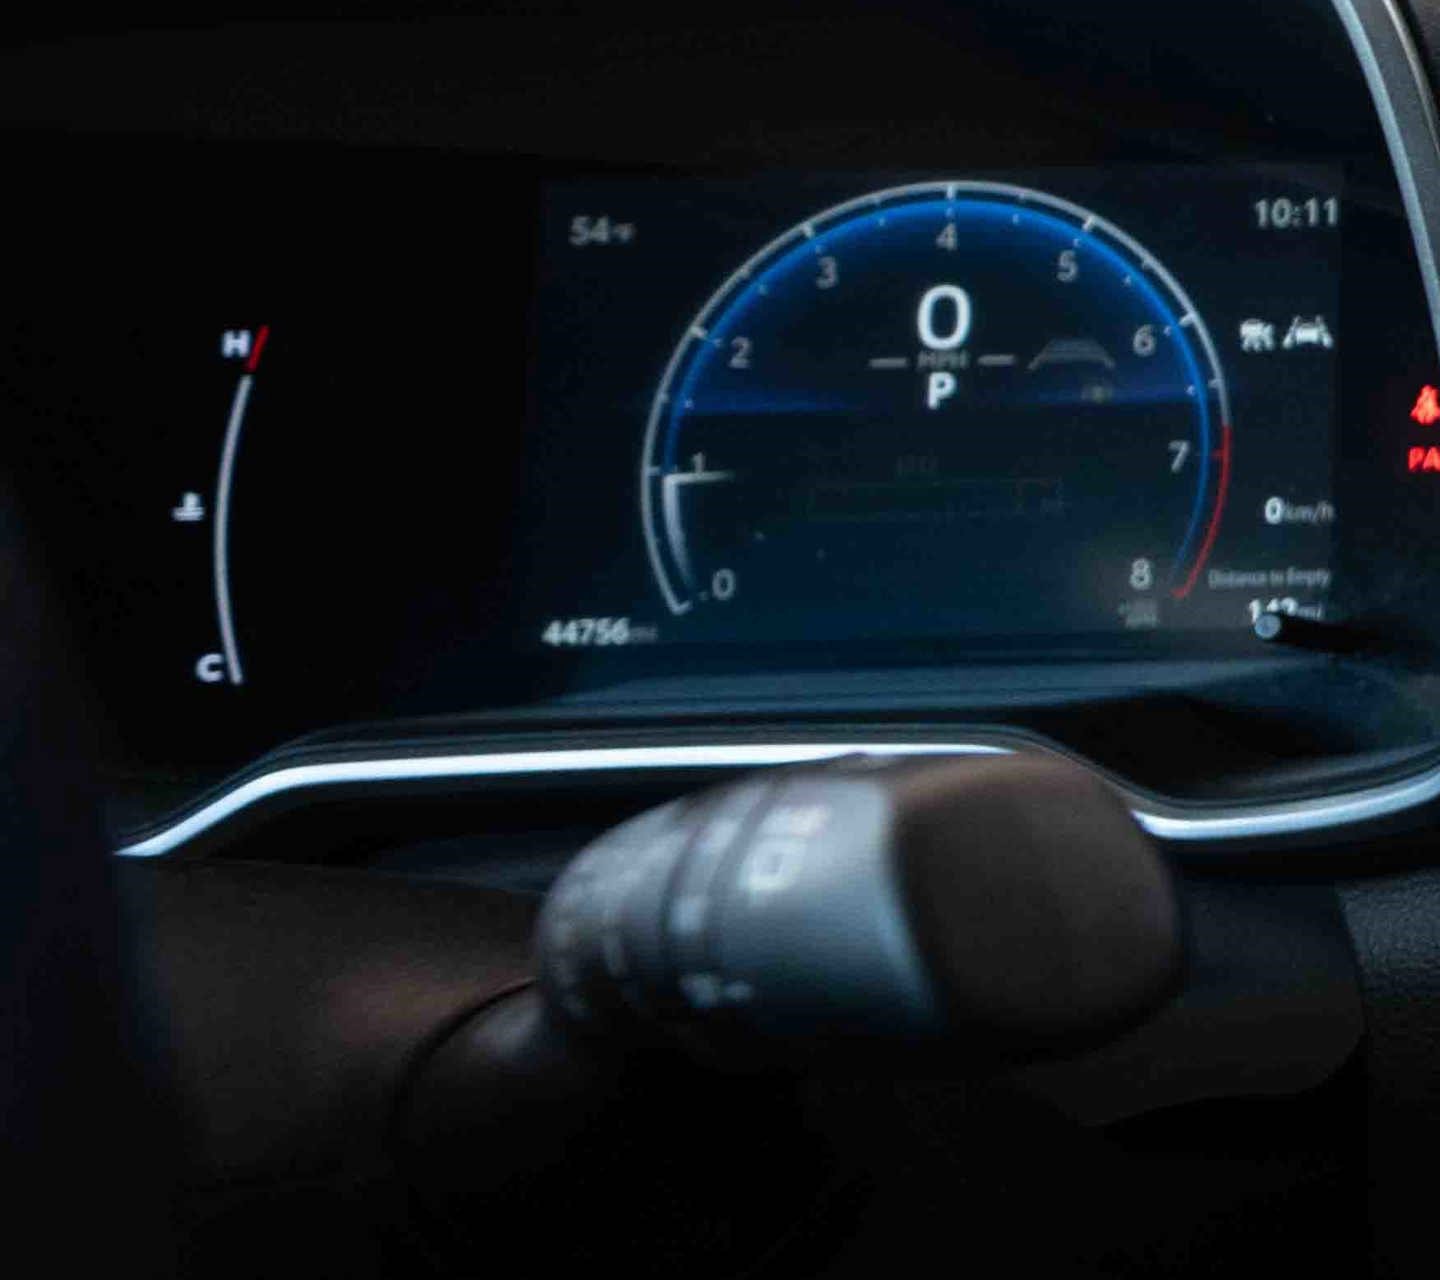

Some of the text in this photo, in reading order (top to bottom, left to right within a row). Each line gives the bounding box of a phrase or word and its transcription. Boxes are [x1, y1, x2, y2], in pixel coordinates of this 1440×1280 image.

[1254, 198, 1337, 228] 10:11
[936, 224, 957, 250] 4
[817, 257, 839, 289] 3
[1057, 252, 1079, 282] 5
[917, 284, 971, 350] 0
[223, 331, 250, 357] H
[730, 338, 752, 369] 2
[1132, 325, 1156, 356] 6
[927, 371, 957, 410] P
[1168, 441, 1189, 472] 7
[712, 568, 735, 600] 0
[1129, 558, 1151, 590] 8
[196, 654, 223, 681] C
